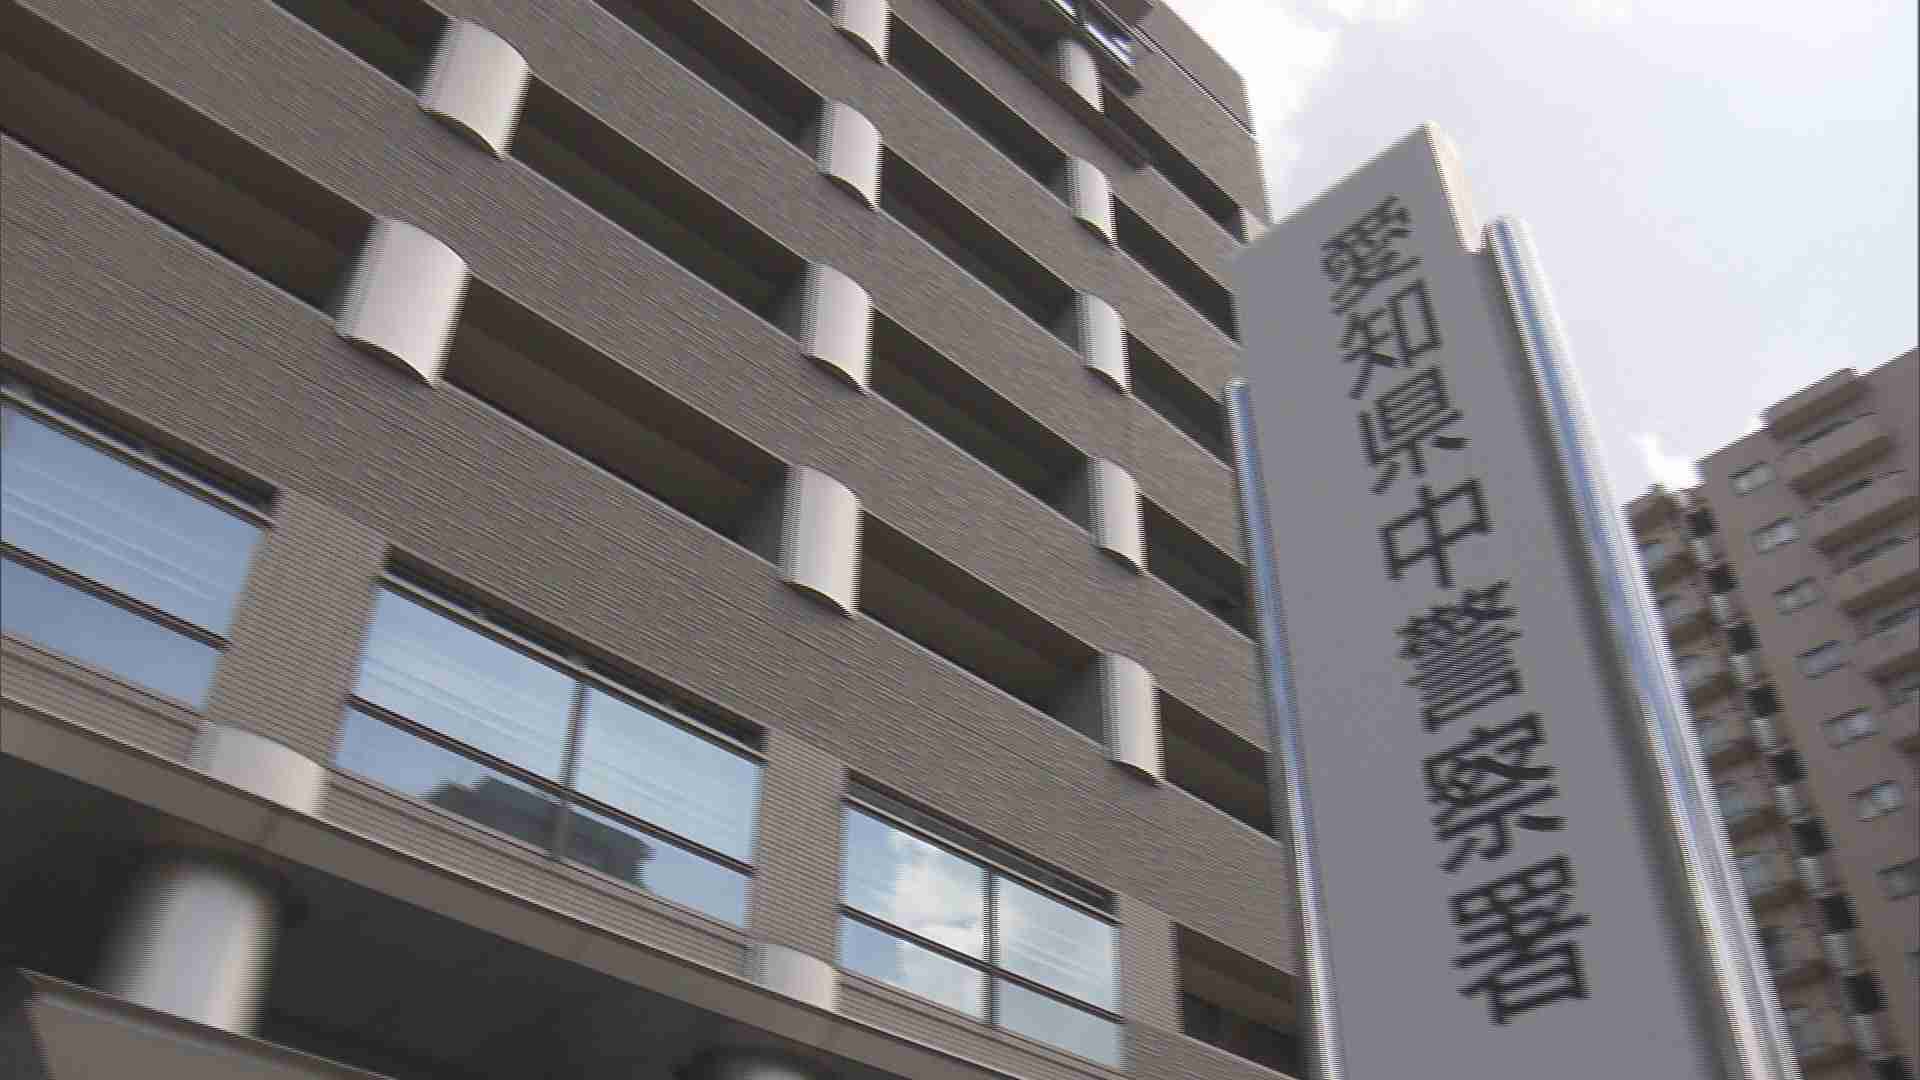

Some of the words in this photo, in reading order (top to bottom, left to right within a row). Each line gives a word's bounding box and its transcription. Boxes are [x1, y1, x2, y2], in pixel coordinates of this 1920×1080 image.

[1320, 195, 1590, 1025] 愛知県中警察署
